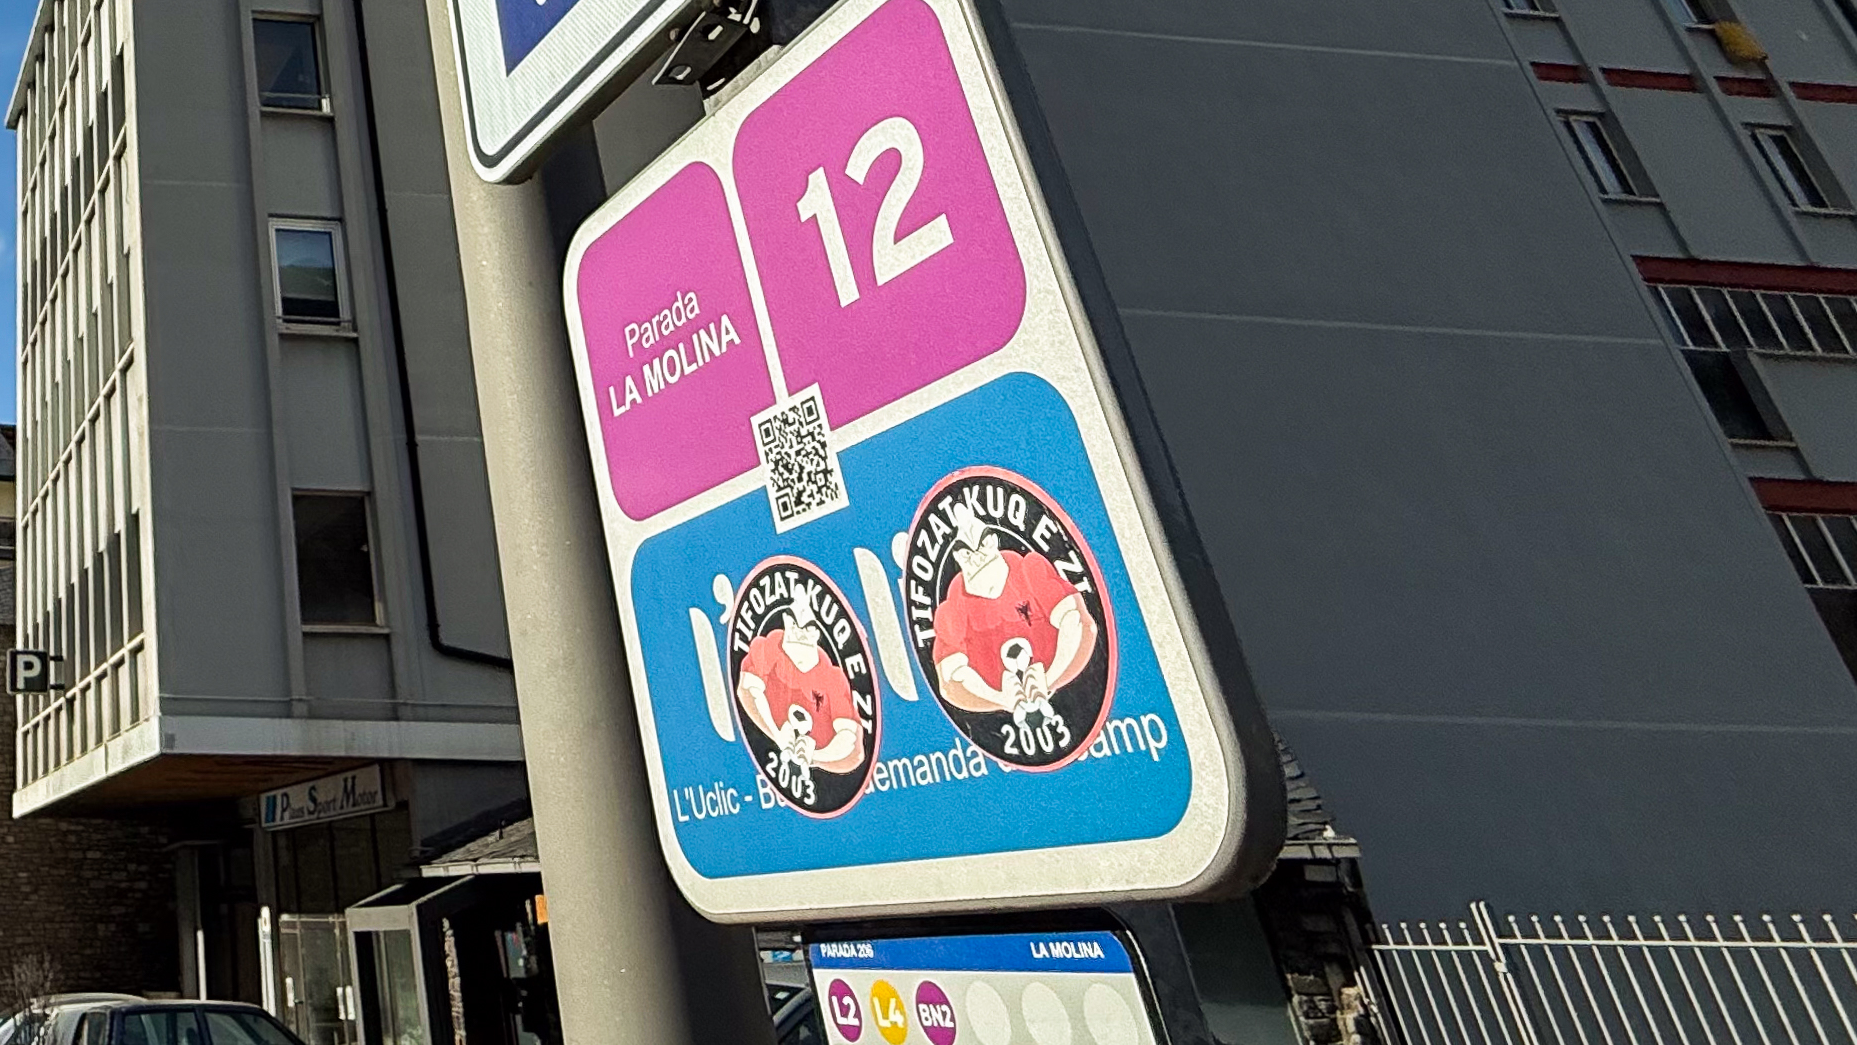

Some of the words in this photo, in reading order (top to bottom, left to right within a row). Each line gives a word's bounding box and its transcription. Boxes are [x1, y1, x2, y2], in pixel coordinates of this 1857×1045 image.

[795, 116, 955, 309] 12
[623, 289, 702, 359] Parada
[608, 375, 642, 417] LA
[643, 313, 742, 398] MOLINA
[909, 494, 958, 649] TIFOZAT
[962, 484, 1027, 531] KUQ
[1031, 515, 1058, 553] E
[734, 571, 800, 653] TIFOZAT
[806, 578, 852, 650] KUQ
[845, 652, 868, 680] E
[16, 654, 41, 689] P
[1001, 714, 1072, 756] 2003
[306, 784, 337, 819] Sport
[340, 775, 378, 810] Motor
[765, 752, 816, 805] 2003
[673, 781, 740, 822] L'Uclic
[820, 943, 858, 958] PARADA
[857, 943, 875, 959] 206
[1030, 941, 1050, 958] LA
[1049, 941, 1105, 959] MOLINA
[831, 995, 860, 1026] L2
[872, 997, 904, 1028] L4
[918, 1003, 955, 1028] BN2
